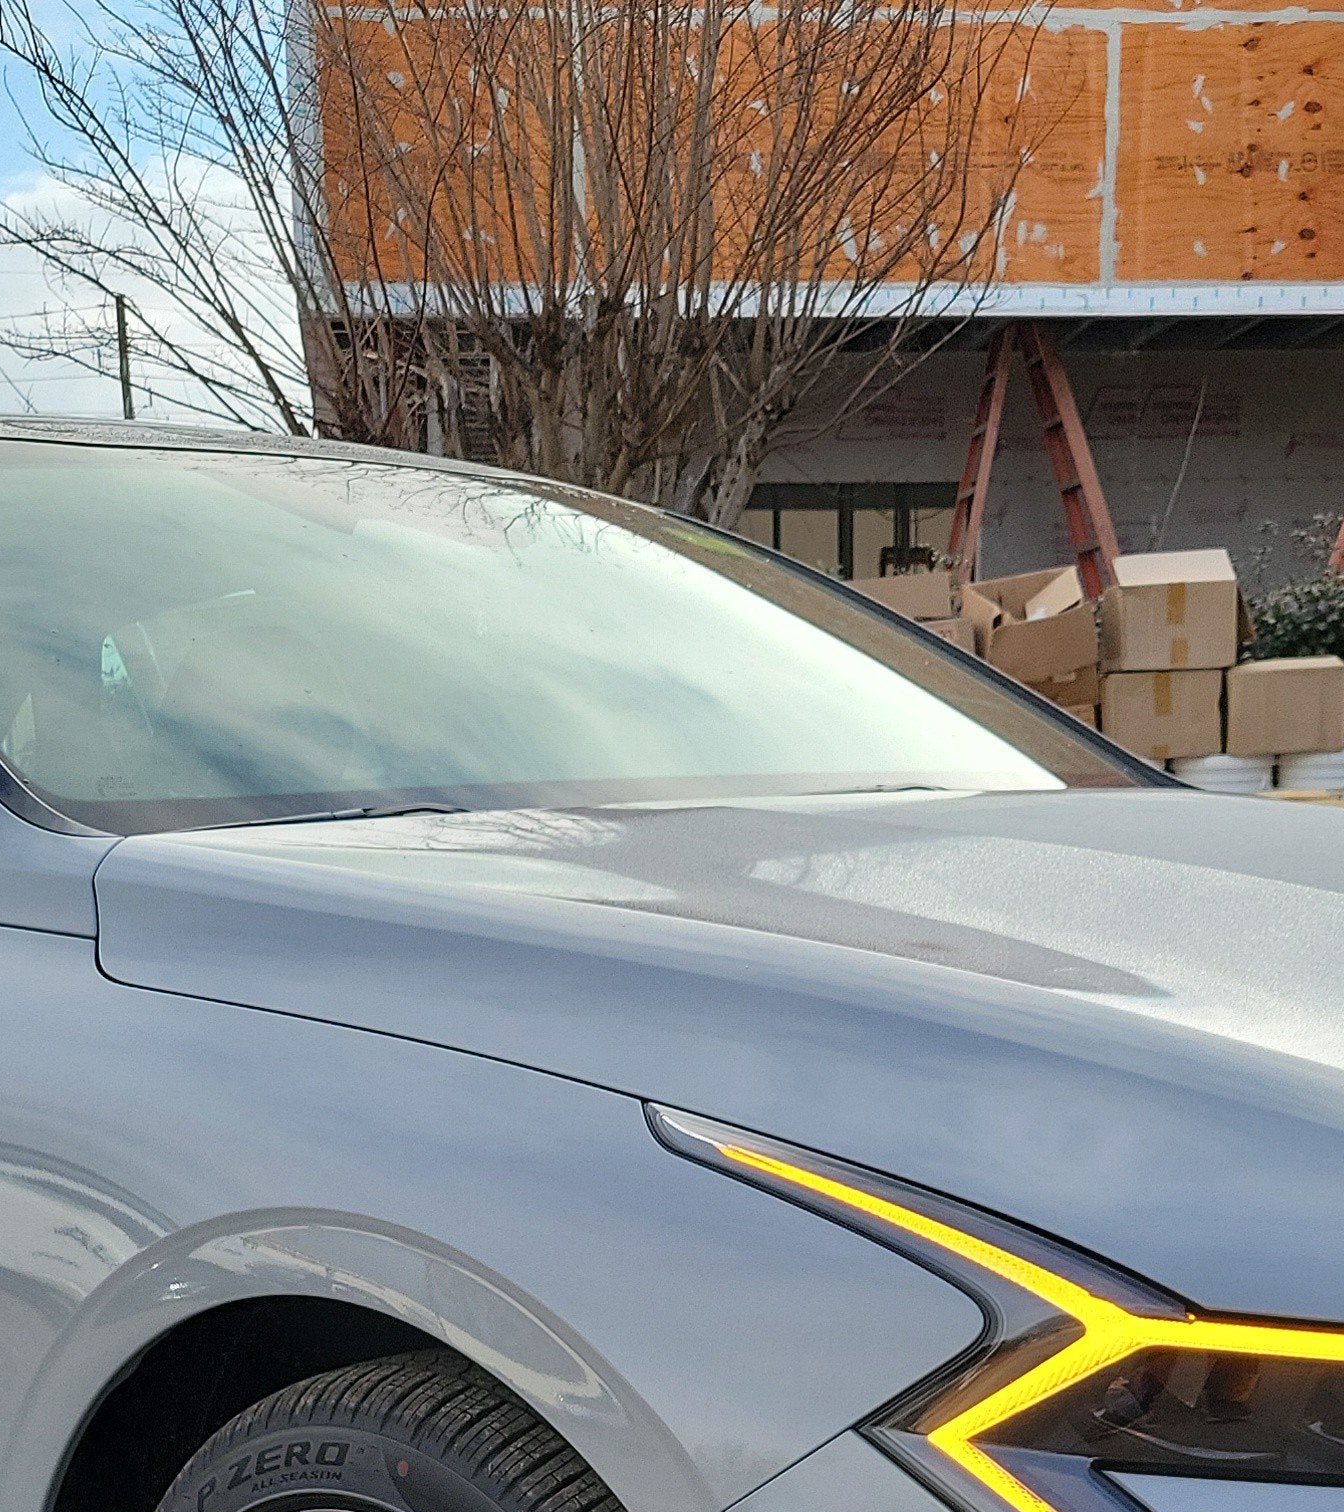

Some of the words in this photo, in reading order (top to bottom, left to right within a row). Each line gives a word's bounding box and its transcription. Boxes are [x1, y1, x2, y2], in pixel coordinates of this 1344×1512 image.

[227, 1441, 351, 1490] ZERO
[251, 1476, 278, 1493] ALL
[280, 1469, 343, 1483] SEASON
